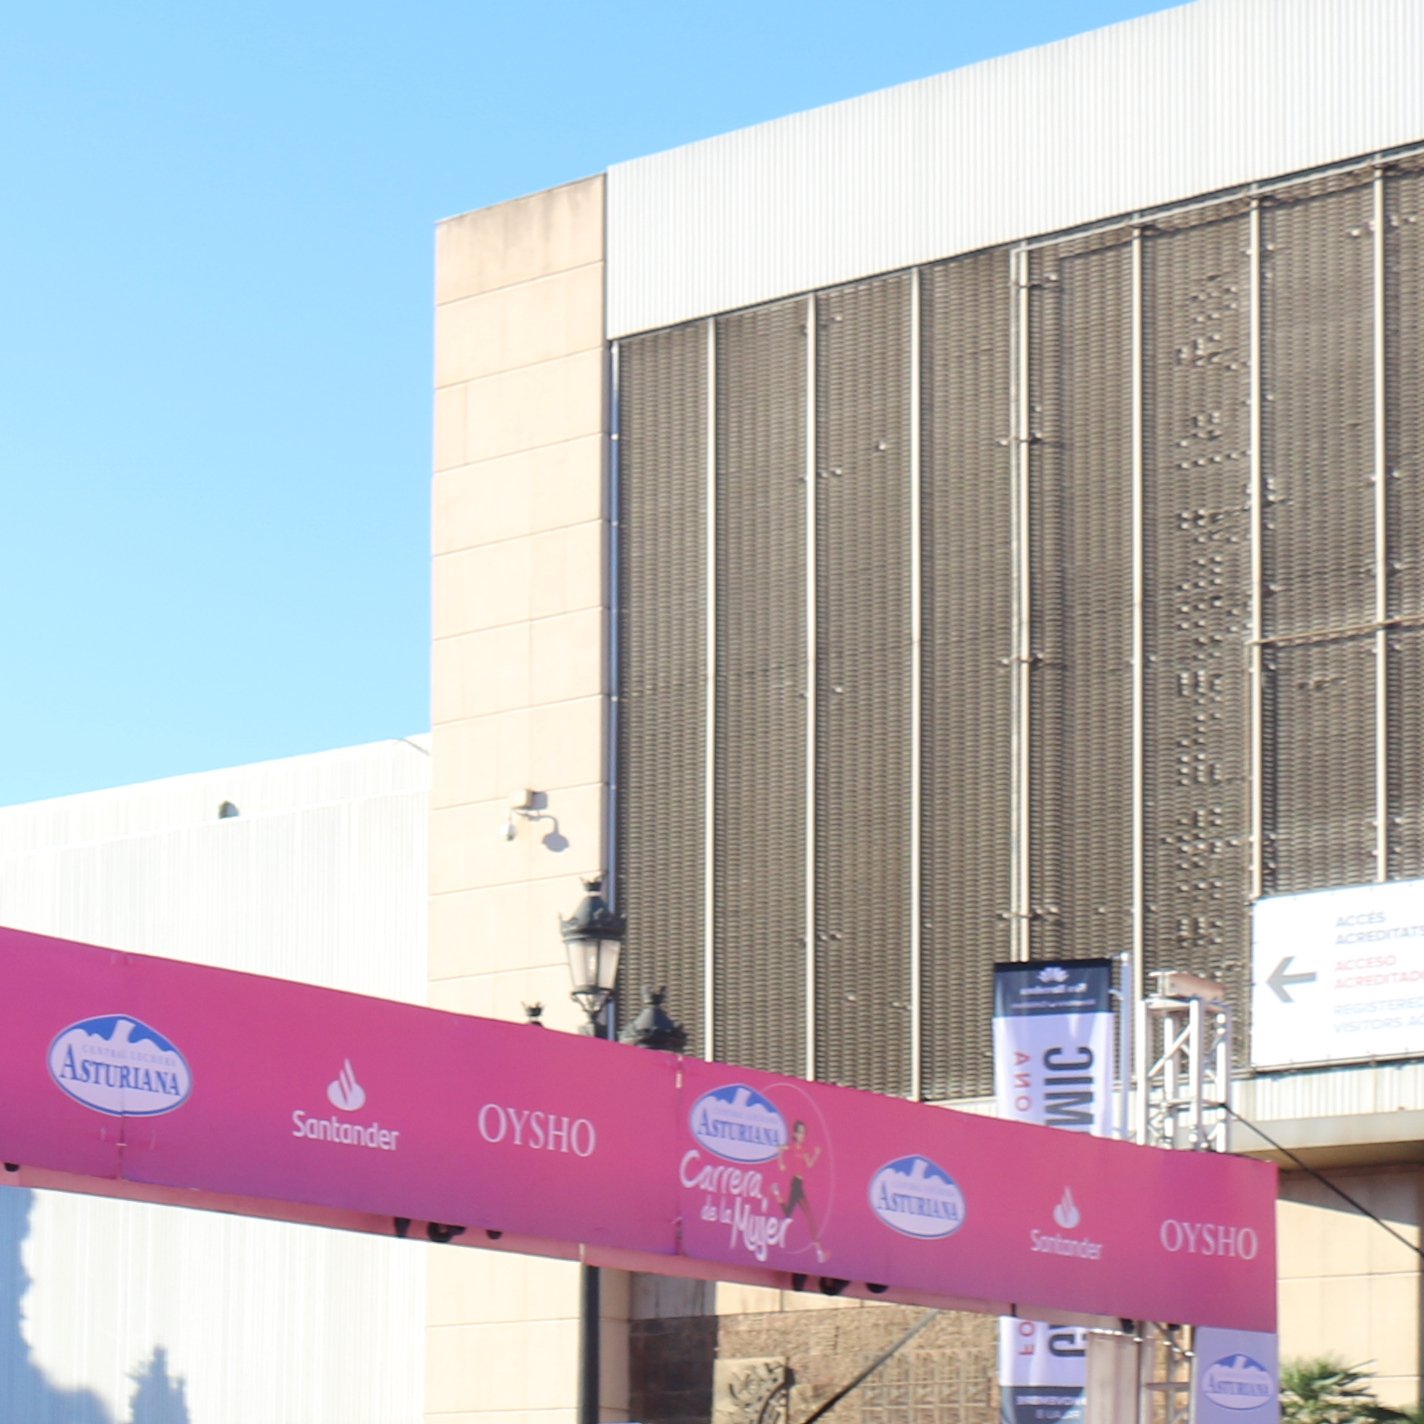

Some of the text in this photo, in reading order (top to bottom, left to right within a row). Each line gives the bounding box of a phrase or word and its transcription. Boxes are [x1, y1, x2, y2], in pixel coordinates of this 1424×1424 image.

[59, 1043, 181, 1097] ASTURIANA
[291, 1109, 399, 1151] Santander
[478, 1103, 596, 1157] OYSHO
[697, 1107, 780, 1147] ASTURIANA
[679, 1150, 763, 1199] Carrera
[876, 1180, 959, 1222] ASTURIANA
[701, 1195, 794, 1262] de la Mujer
[1030, 1229, 1103, 1260] Santander
[1159, 1219, 1258, 1261] OYSHO
